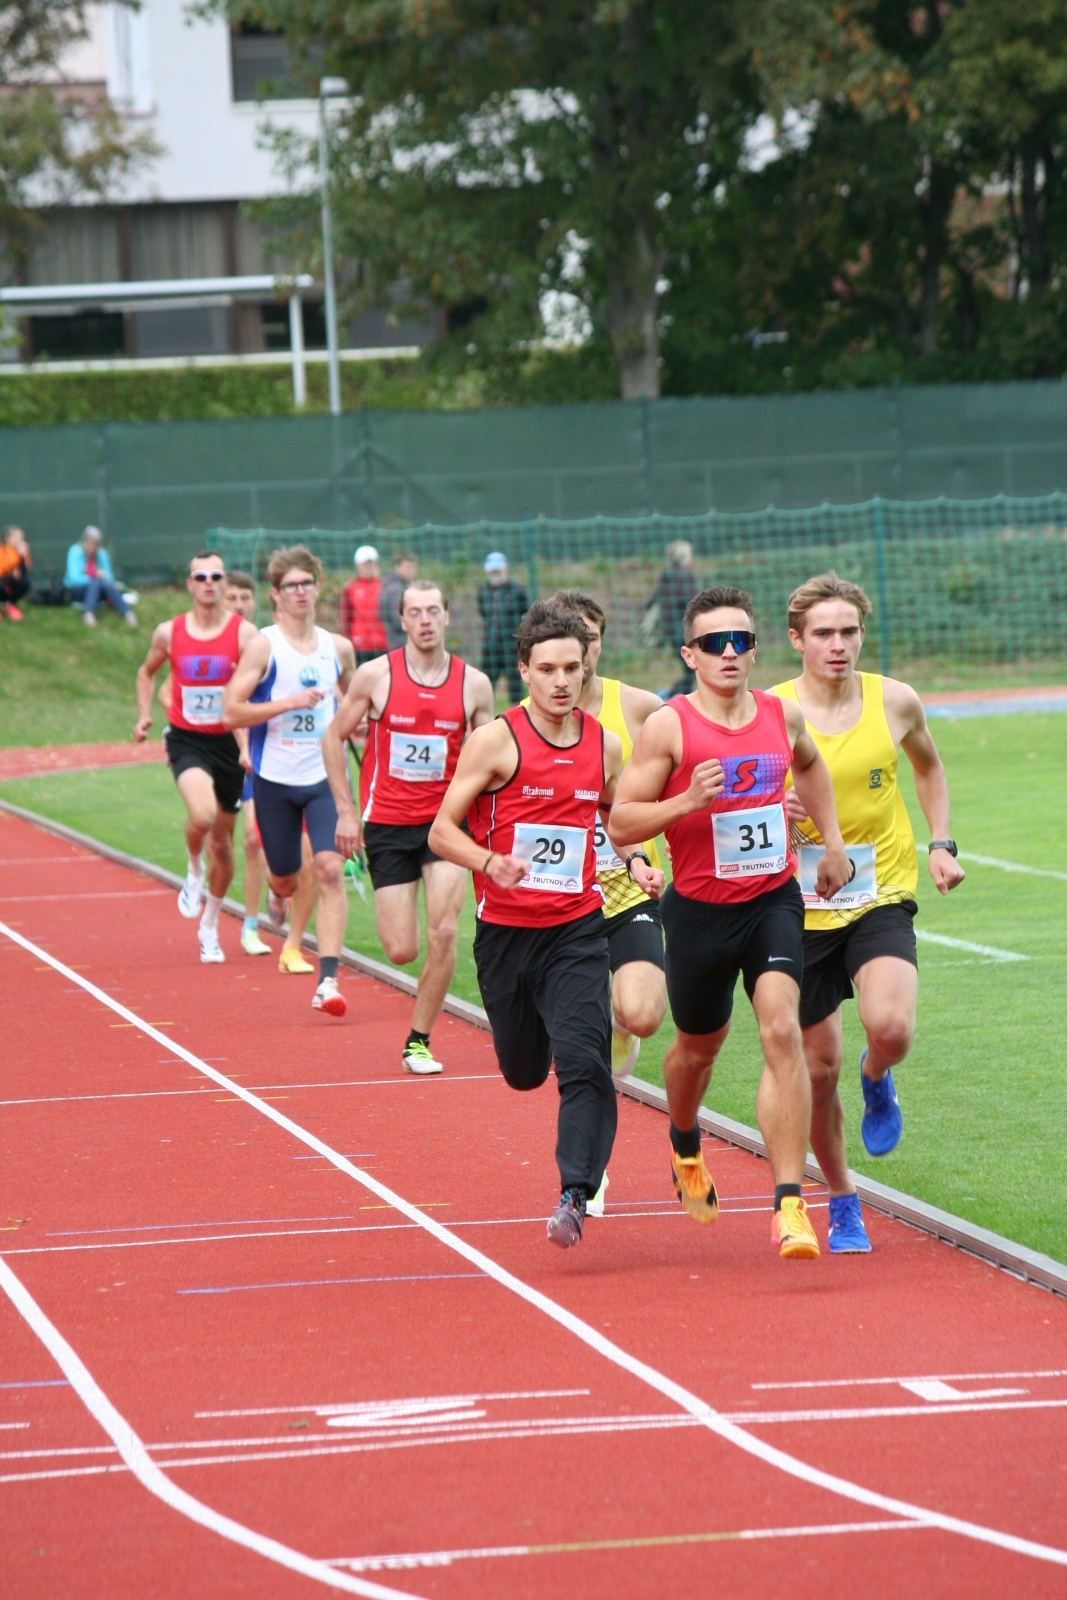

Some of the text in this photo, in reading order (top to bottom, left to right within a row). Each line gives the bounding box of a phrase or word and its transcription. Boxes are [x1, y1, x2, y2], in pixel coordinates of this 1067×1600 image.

[194, 694, 214, 710] 27
[292, 714, 315, 732] 28
[404, 743, 430, 763] 24
[594, 822, 606, 848] 5
[738, 821, 773, 852] 31
[532, 837, 566, 865] 29
[742, 861, 774, 871] TRUTNOV
[532, 876, 564, 886] TRUTNOV
